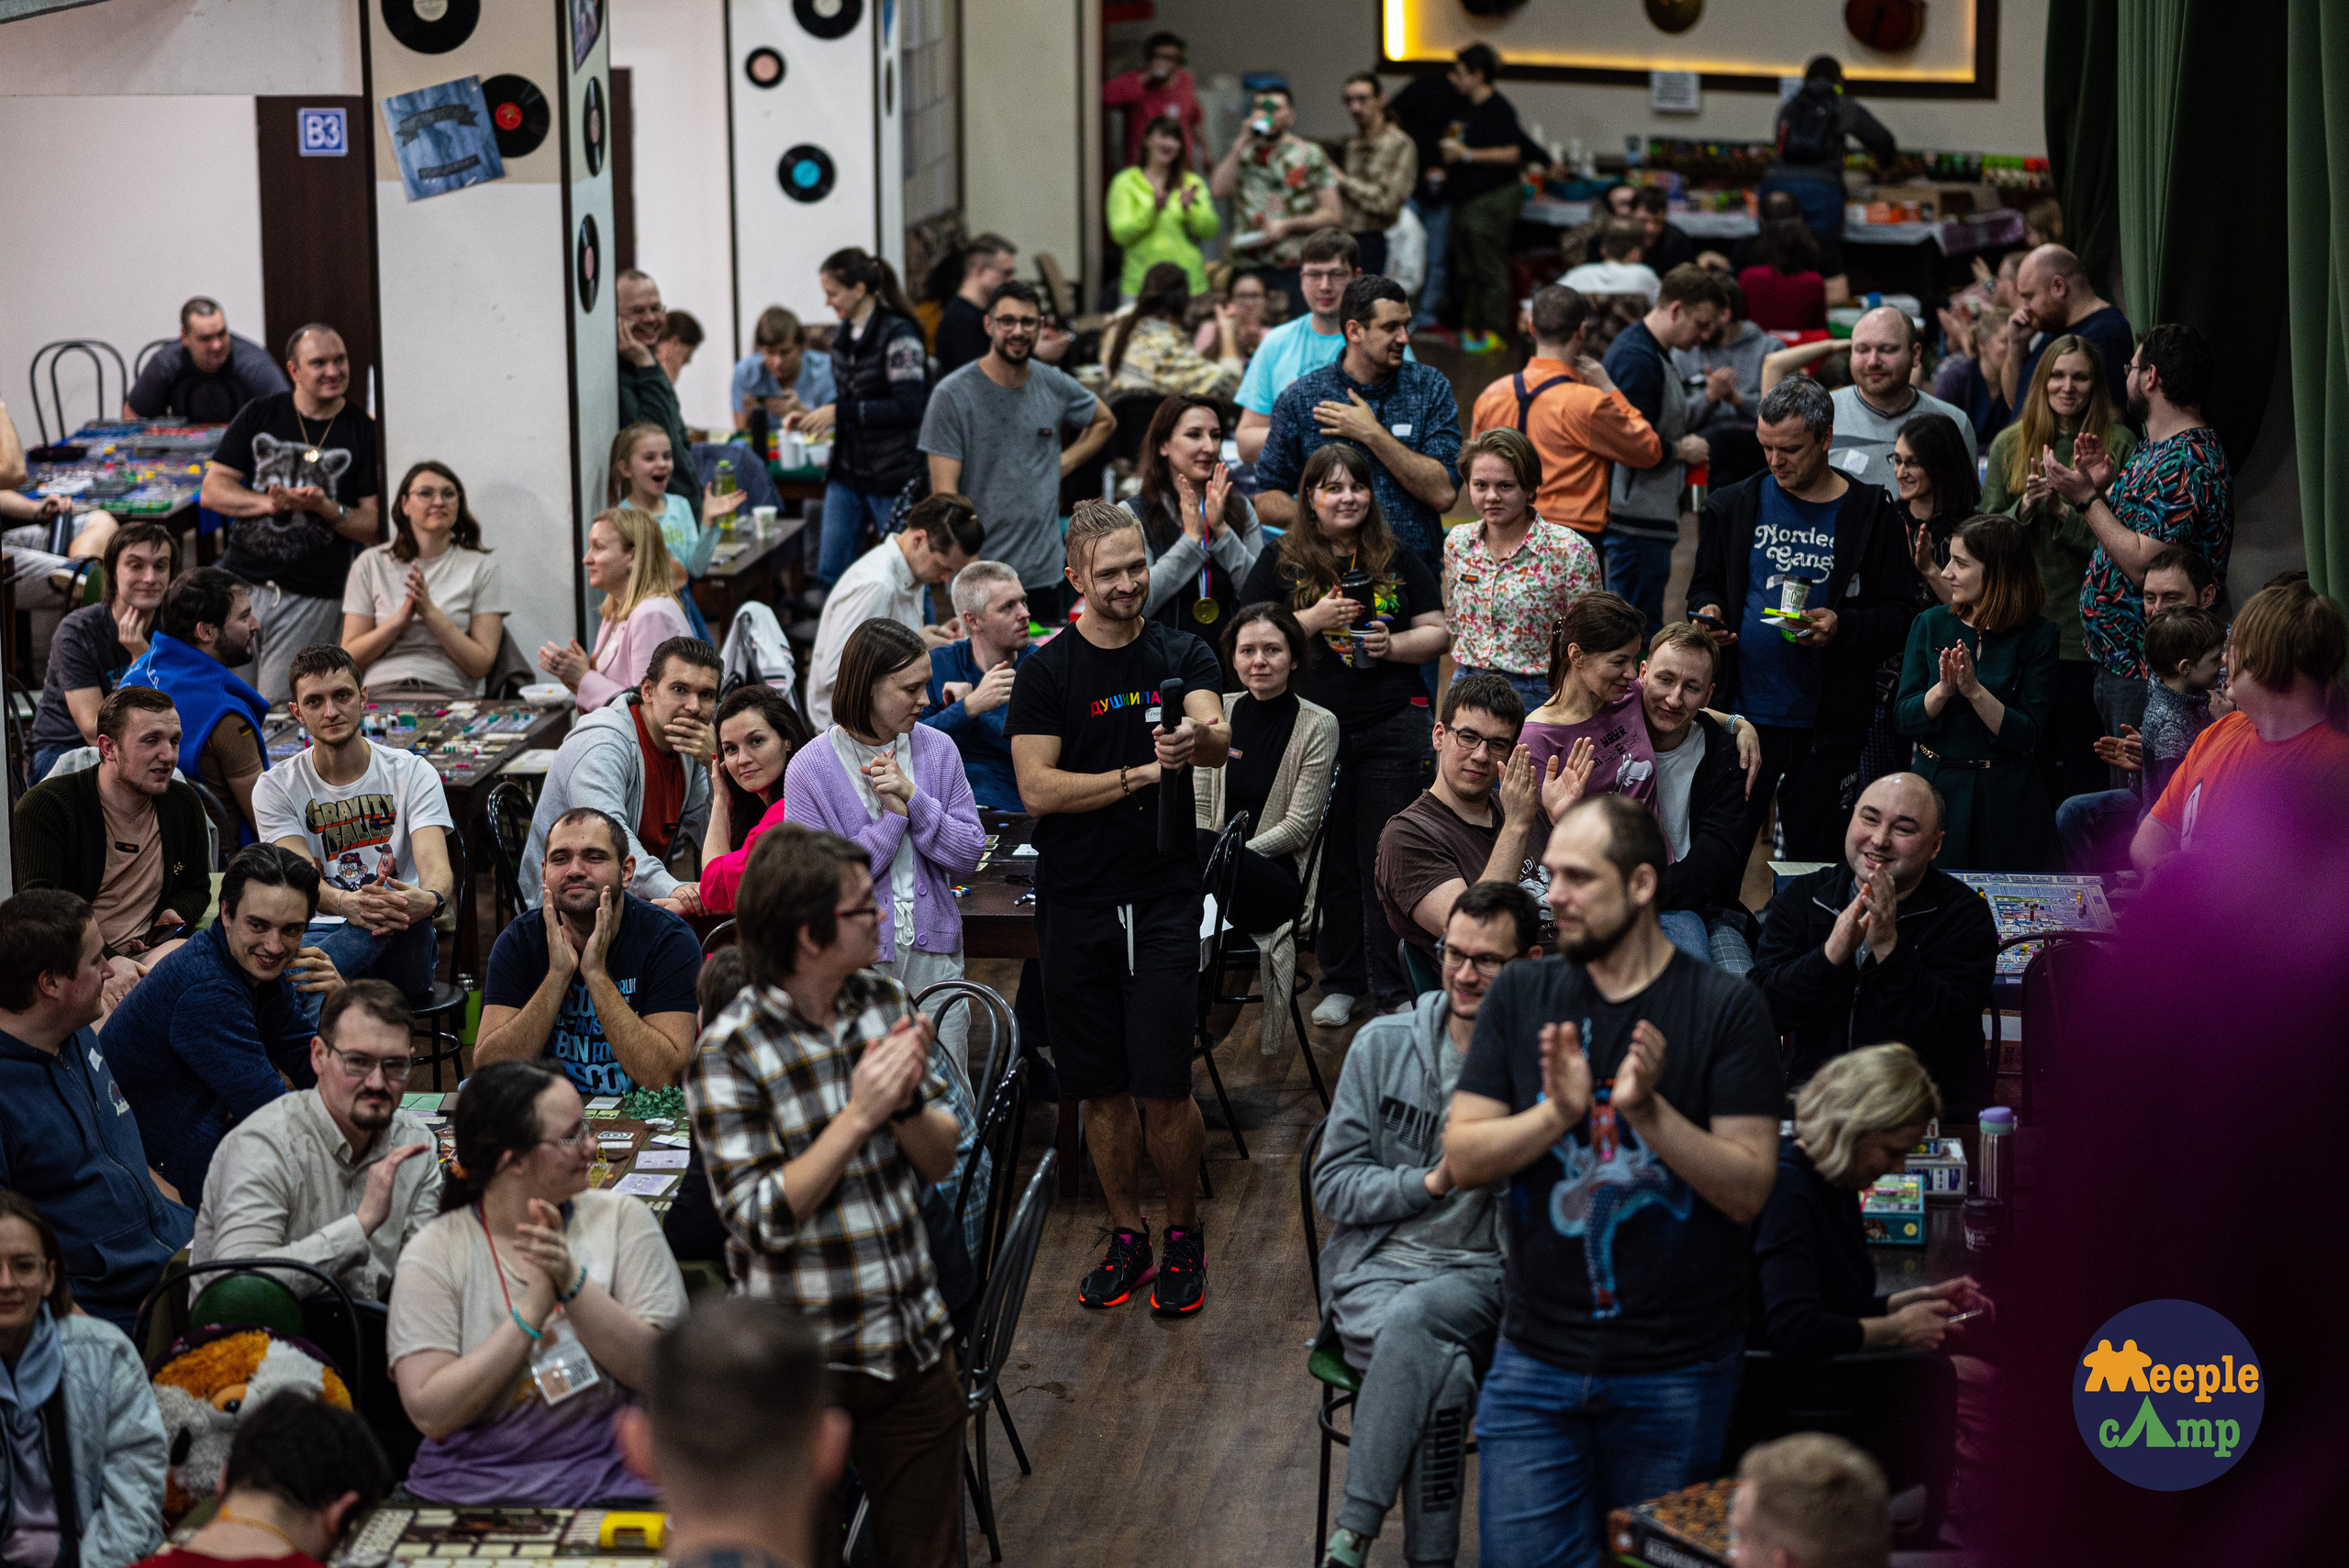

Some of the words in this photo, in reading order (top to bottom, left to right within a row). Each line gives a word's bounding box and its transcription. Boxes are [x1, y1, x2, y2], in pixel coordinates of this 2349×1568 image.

[306, 115, 341, 150] B3
[1090, 690, 1161, 717] ДУШНИЛА
[306, 794, 396, 834] GRAVITY
